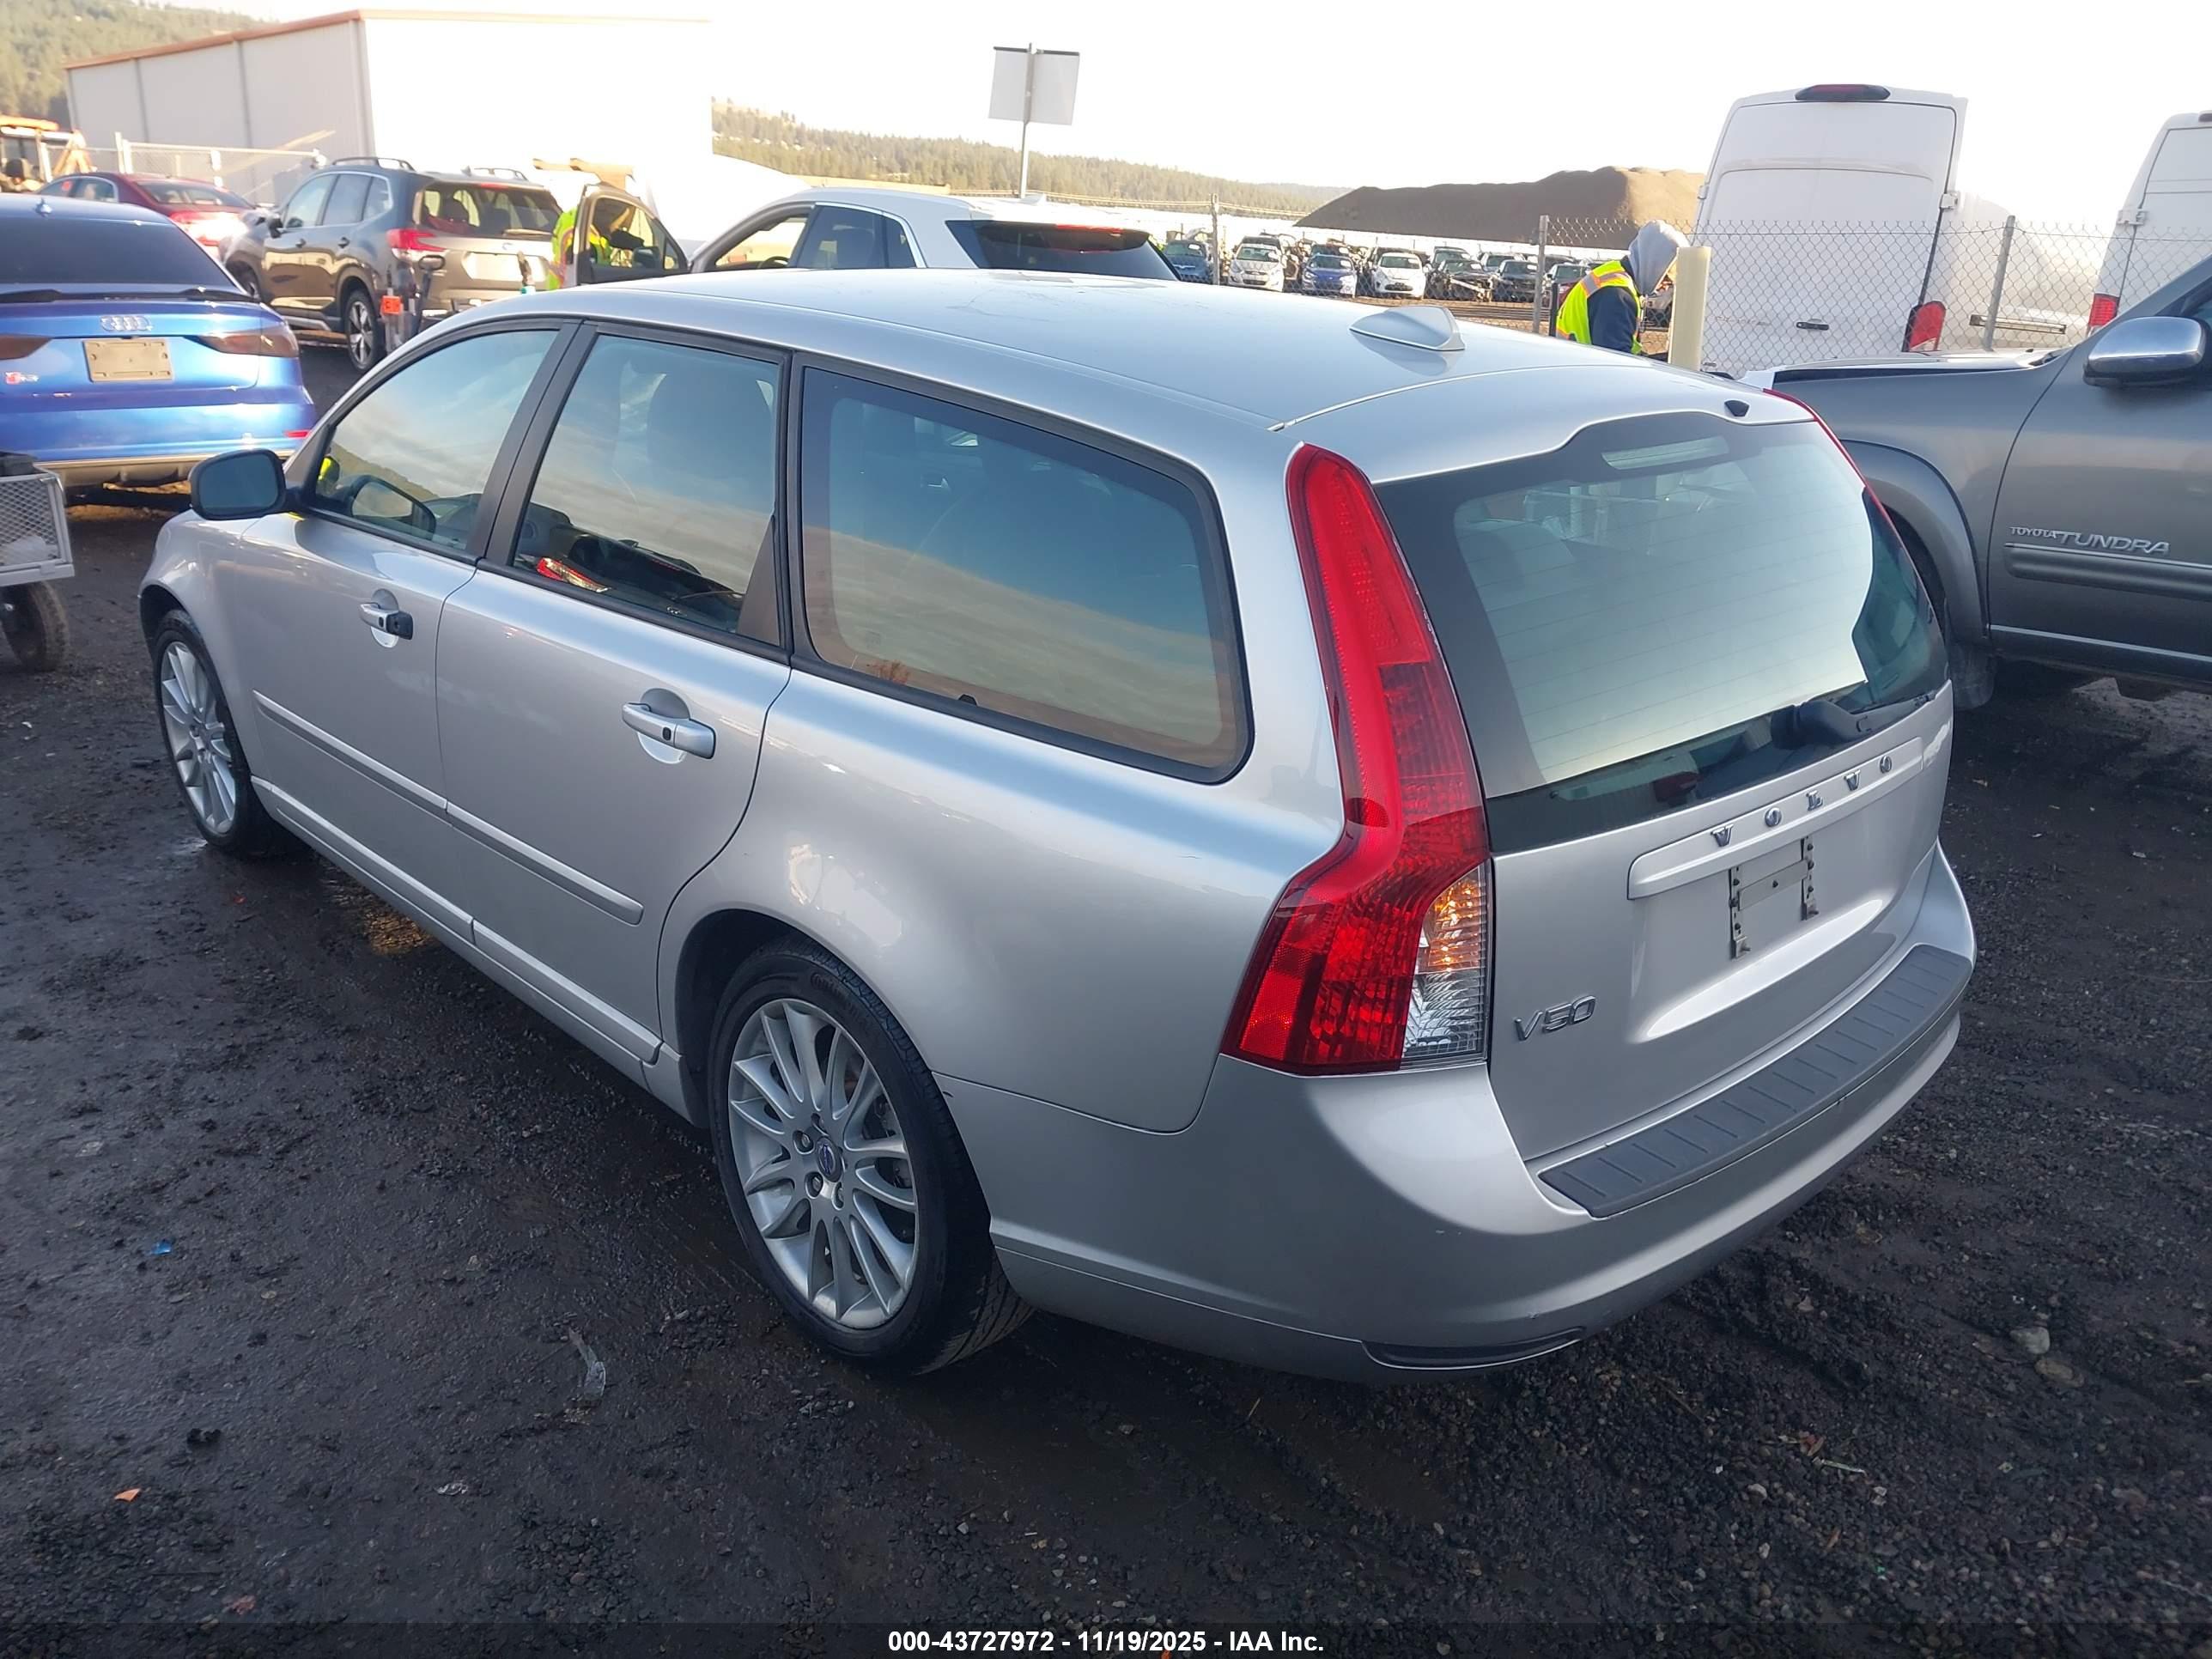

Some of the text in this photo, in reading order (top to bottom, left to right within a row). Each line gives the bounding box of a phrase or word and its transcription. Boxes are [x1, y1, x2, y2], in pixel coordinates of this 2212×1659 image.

[2009, 526, 2171, 554] TOYOTA TUNDRA
[1710, 755, 1893, 848] VOLVO
[1514, 995, 1597, 1042] V50
